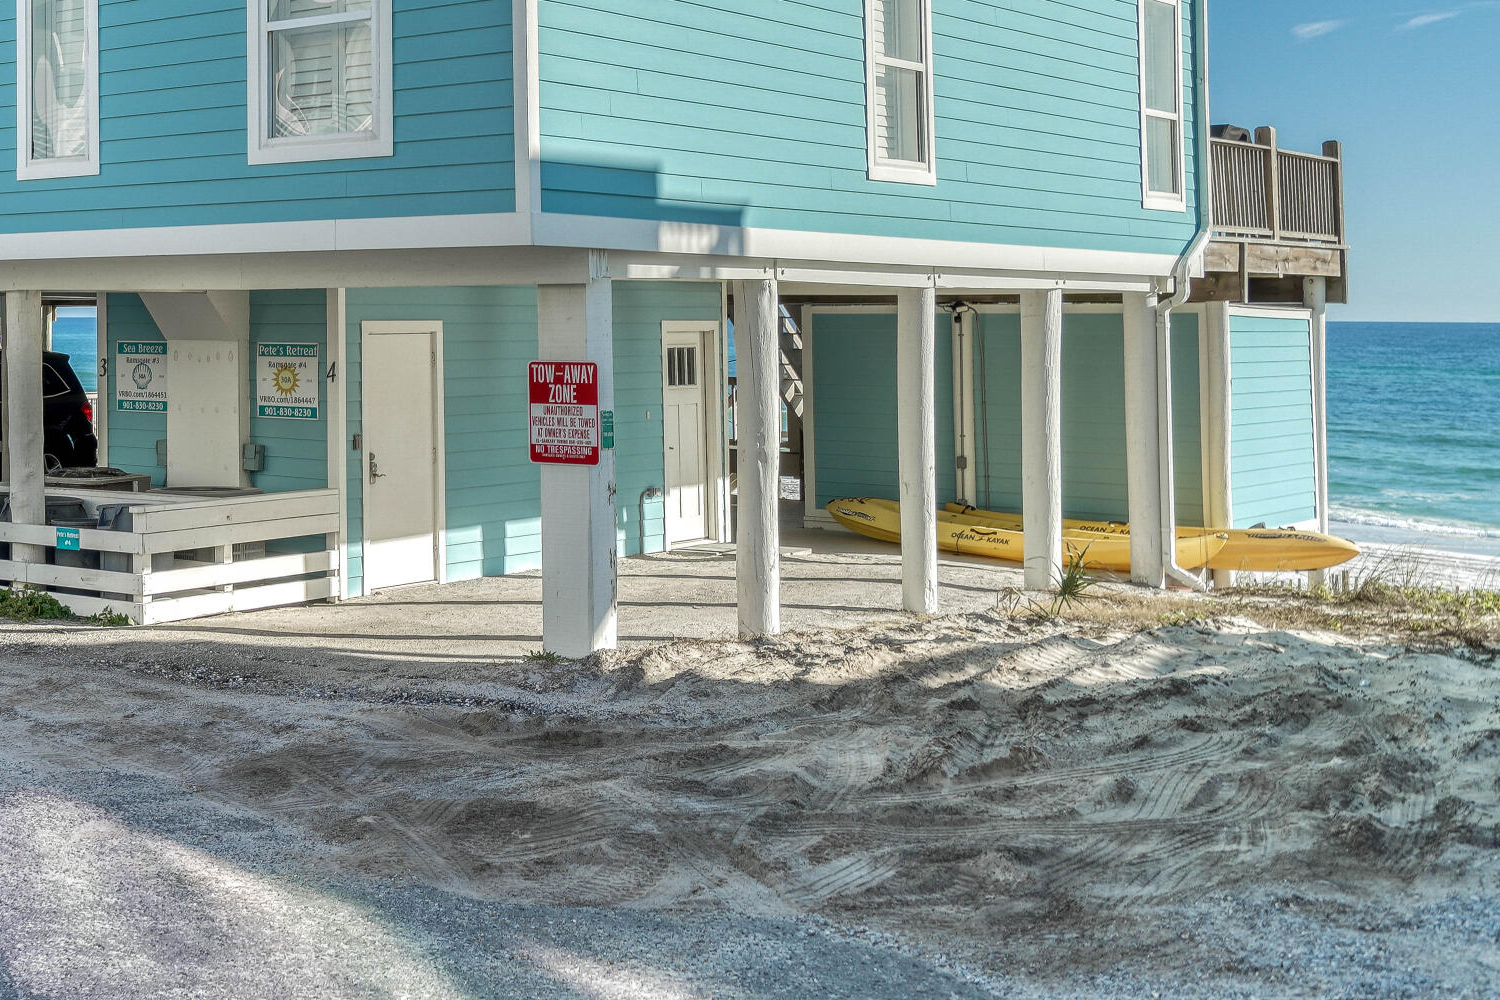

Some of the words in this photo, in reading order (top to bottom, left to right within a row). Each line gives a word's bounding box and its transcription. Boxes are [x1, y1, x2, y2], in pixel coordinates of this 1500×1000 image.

[123, 343, 136, 353] Sea
[138, 343, 164, 353] Breeze
[259, 345, 284, 355] Pete's
[286, 345, 317, 356] Retreat
[99, 358, 107, 377] 3
[268, 361, 296, 369] Ramsgate
[298, 361, 307, 369] #4
[326, 360, 337, 383] 4
[531, 364, 595, 384] TOW-AWAY
[548, 384, 578, 403] ZONE
[122, 401, 164, 410] 901-830-8230
[543, 405, 584, 416] UNAUTHORIZED
[264, 407, 312, 417] 901-830-8230
[531, 416, 555, 427] VEHICLES
[556, 417, 569, 428] WILL
[569, 417, 577, 428] BE
[578, 418, 596, 428] TOWED
[537, 427, 543, 438] AT
[544, 428, 567, 439] OWNER'S
[568, 429, 590, 440] EXPENSE
[535, 445, 545, 453] NO
[547, 445, 592, 456] TRESPASSING
[1080, 525, 1107, 533] OCEAN
[951, 532, 975, 541] OCEAN
[986, 536, 1010, 545] KAYAK
